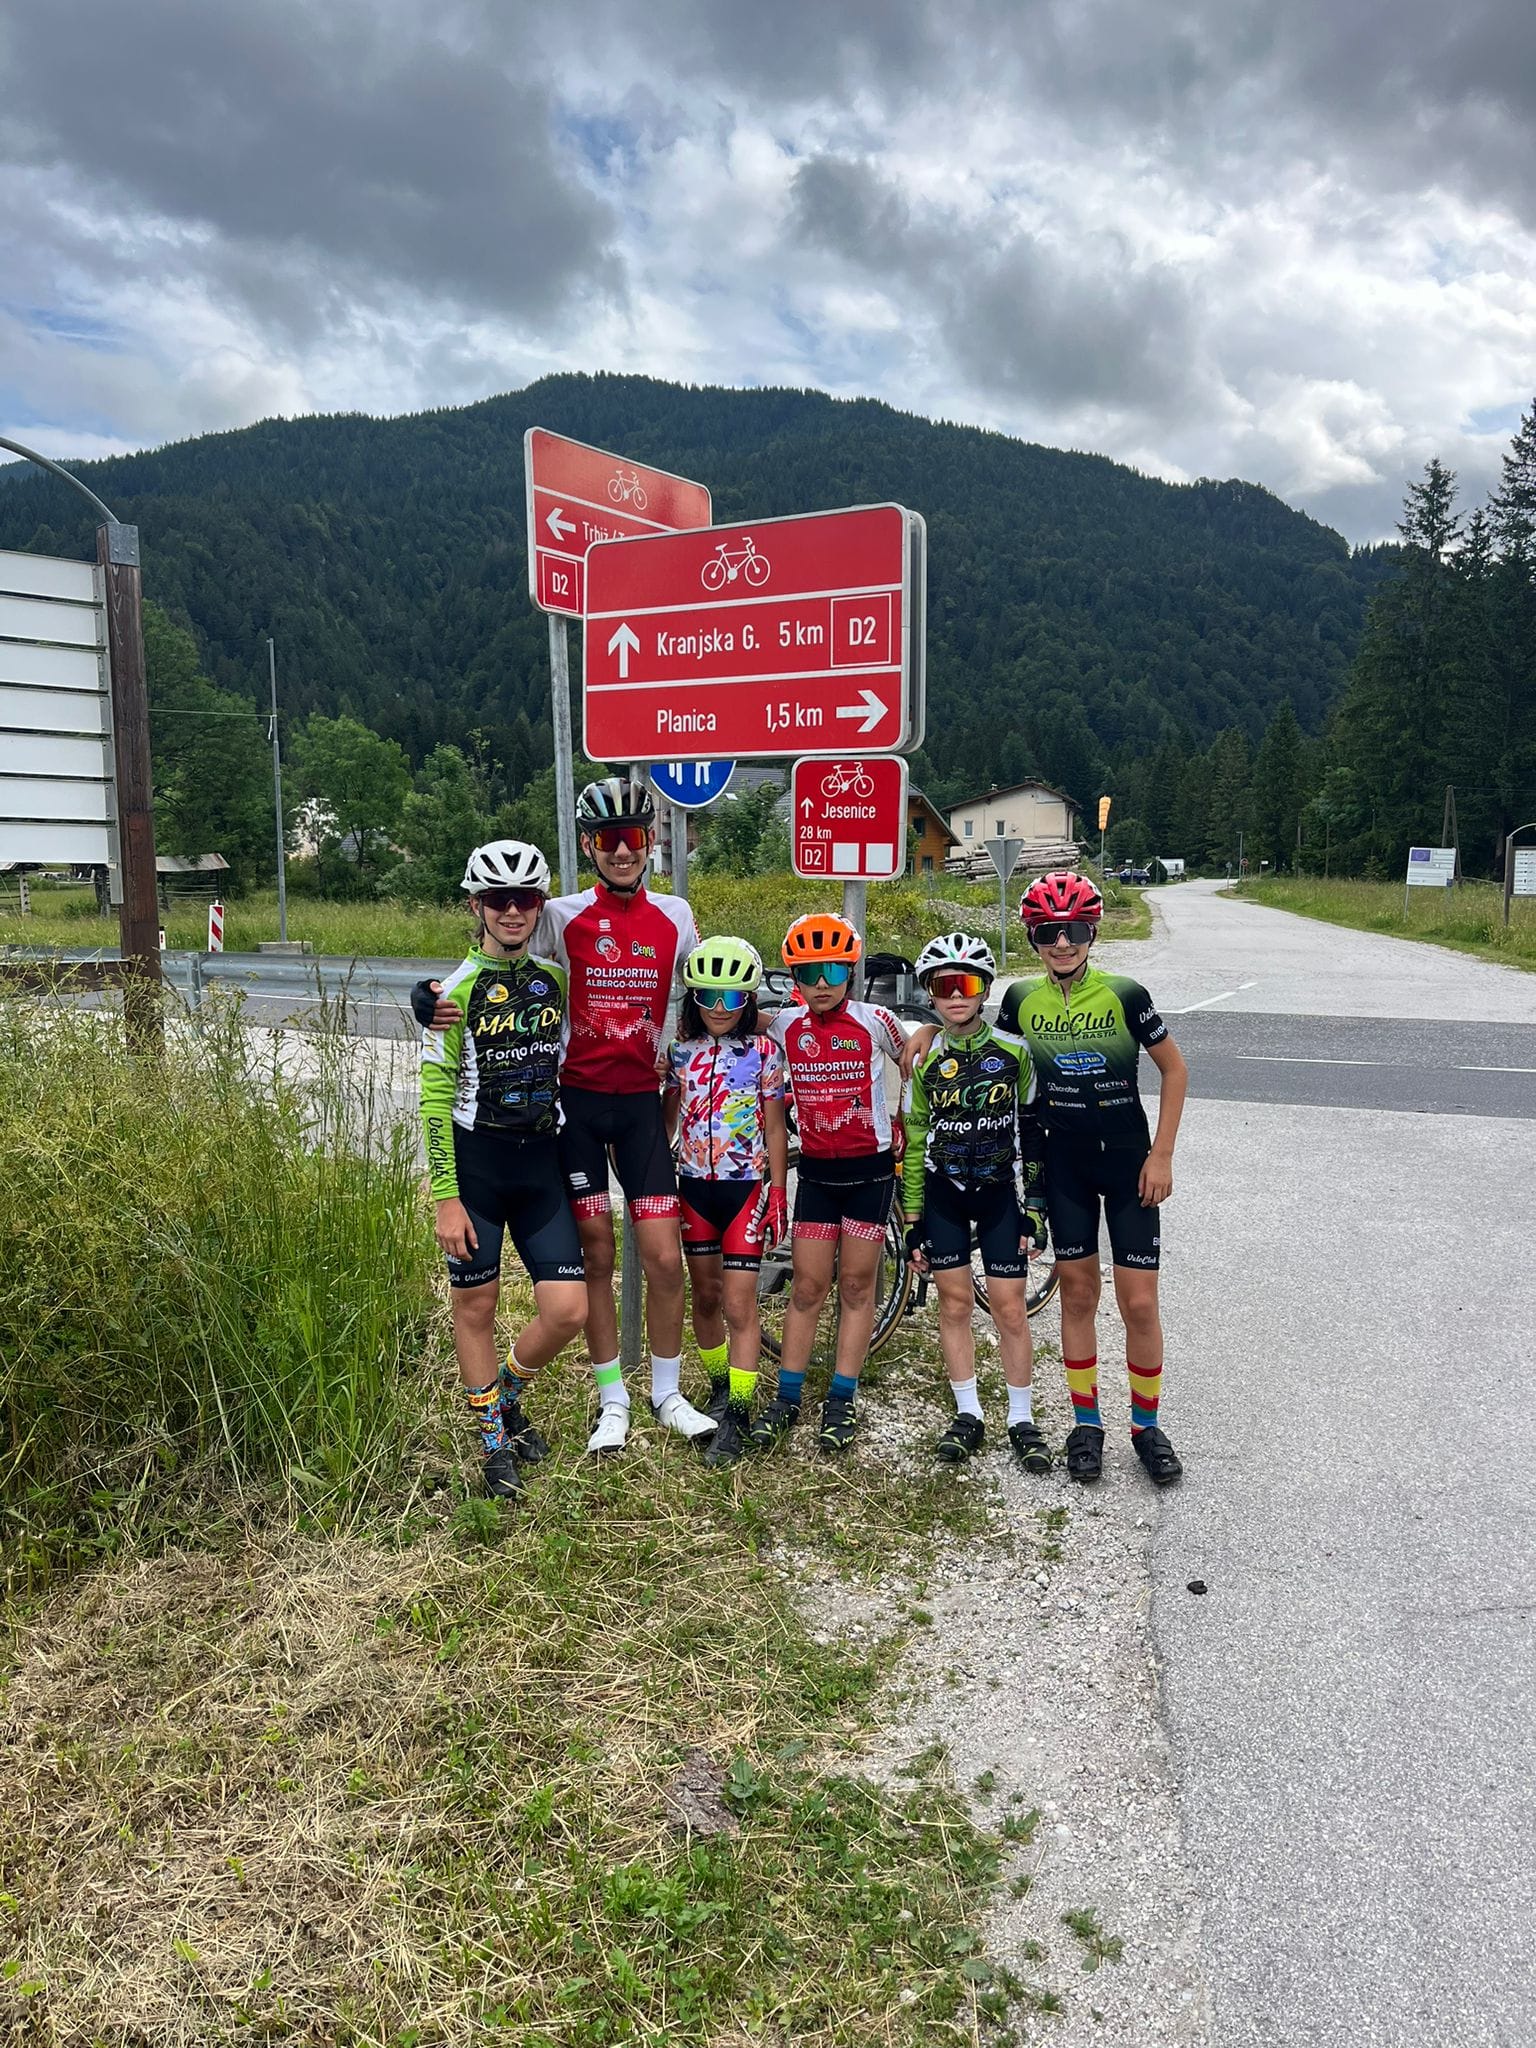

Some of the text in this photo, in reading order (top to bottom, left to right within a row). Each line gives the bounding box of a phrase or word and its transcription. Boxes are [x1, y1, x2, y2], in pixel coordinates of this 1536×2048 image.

[552, 571, 569, 596] D2
[849, 616, 877, 646] D2
[657, 620, 823, 660] Kranjska G. 5 km
[657, 702, 823, 733] Planica 1,5 km
[821, 802, 876, 819] Jesenice
[800, 825, 832, 839] 28 km
[804, 848, 822, 866] D2
[586, 967, 659, 979] POLISPORTIVA
[586, 979, 658, 989] ALBERGO-OLIVETO
[1031, 1009, 1115, 1037] VeloClub
[1082, 1030, 1117, 1040] BASTIA
[486, 1047, 528, 1062] Forno
[791, 1060, 865, 1072] POLISPORTIVA
[936, 1118, 972, 1134] Forno
